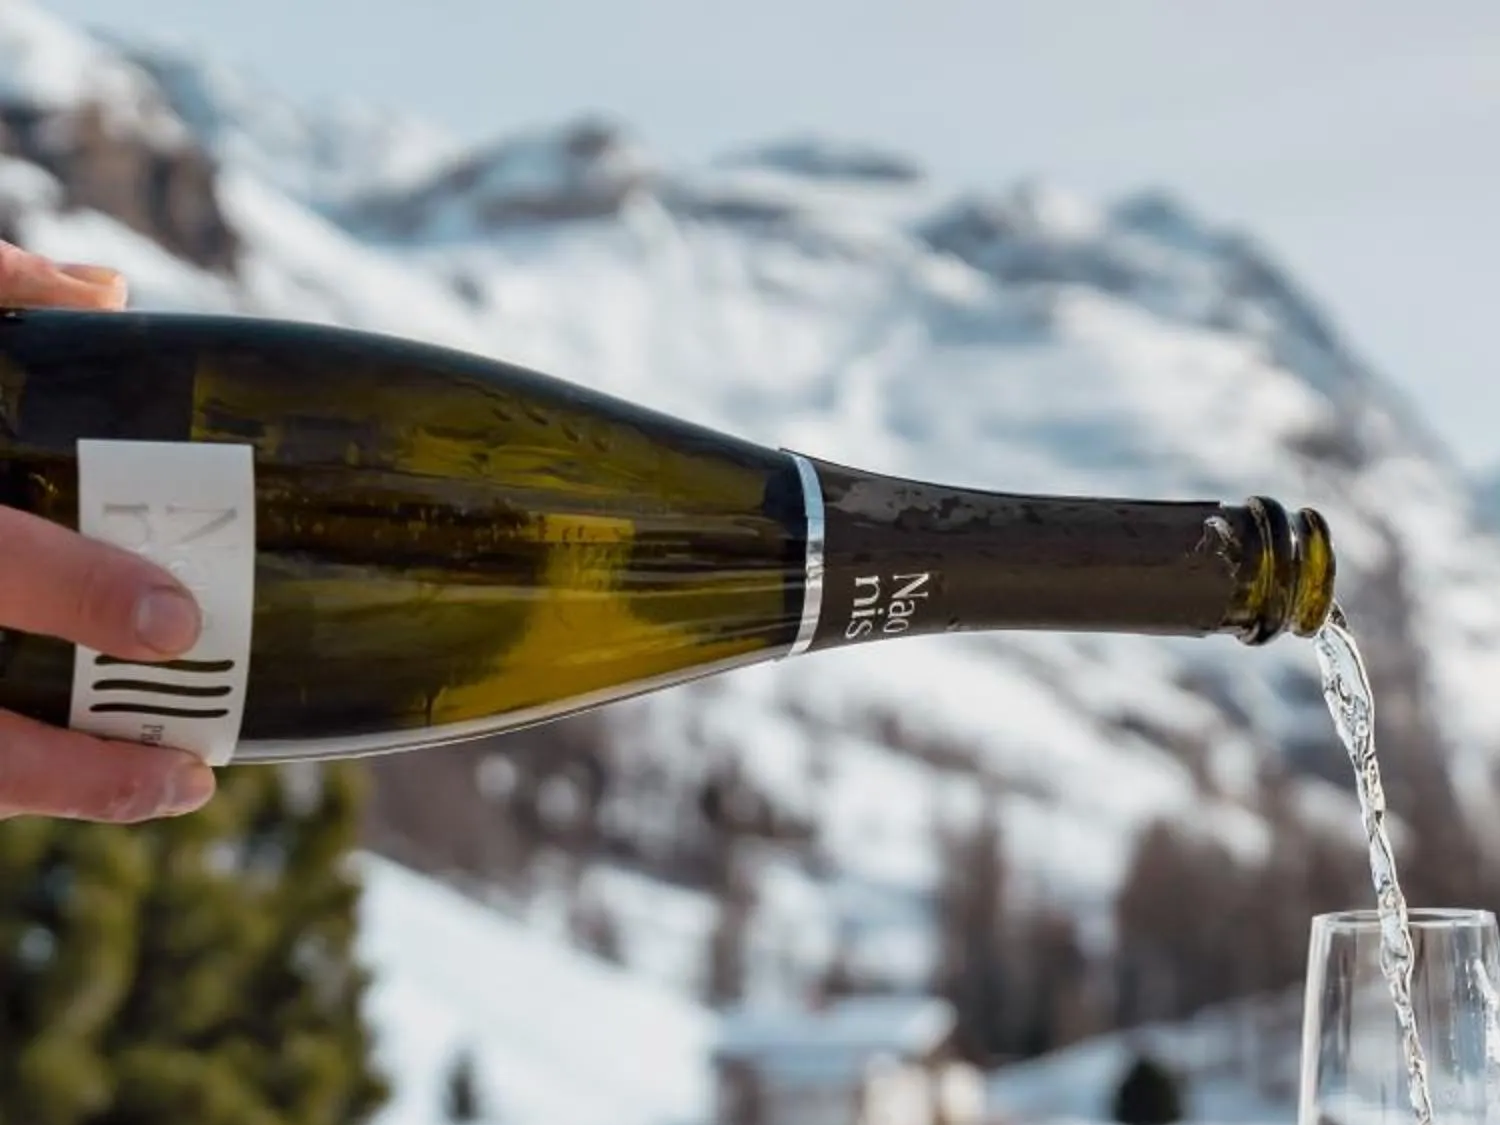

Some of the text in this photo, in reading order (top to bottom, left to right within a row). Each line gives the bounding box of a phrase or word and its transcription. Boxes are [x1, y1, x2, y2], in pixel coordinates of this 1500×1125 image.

[162, 502, 239, 632] Na
[845, 575, 884, 639] nis
[883, 572, 931, 633] Nao
